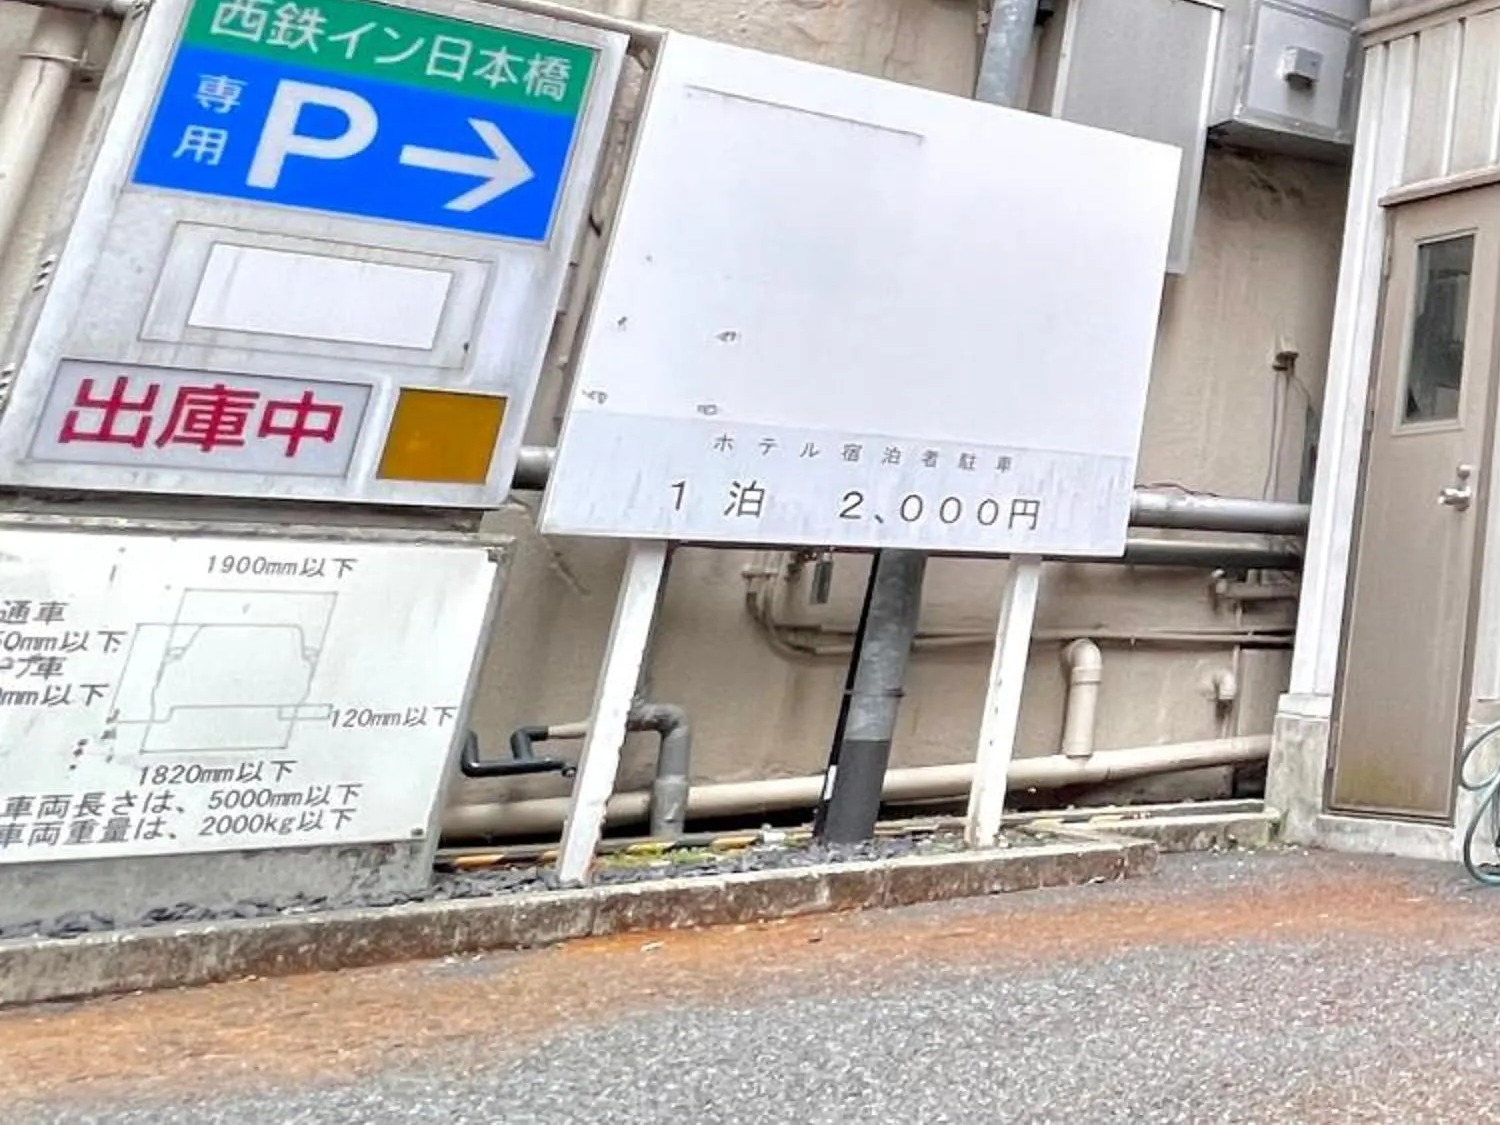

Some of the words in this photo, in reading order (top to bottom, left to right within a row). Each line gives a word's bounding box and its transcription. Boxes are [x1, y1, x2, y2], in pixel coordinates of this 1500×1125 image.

[172, 72, 249, 166] 専用
[246, 78, 379, 189] P
[57, 376, 344, 457] 出庫中
[713, 434, 1012, 473] ホテル宿泊者駐車
[208, 555, 358, 578] 1900mm以下
[0, 630, 127, 653] 0mm以下
[0, 683, 110, 706] mm以下
[331, 707, 457, 727] 120mm以下
[139, 760, 297, 785] 1820mm以下
